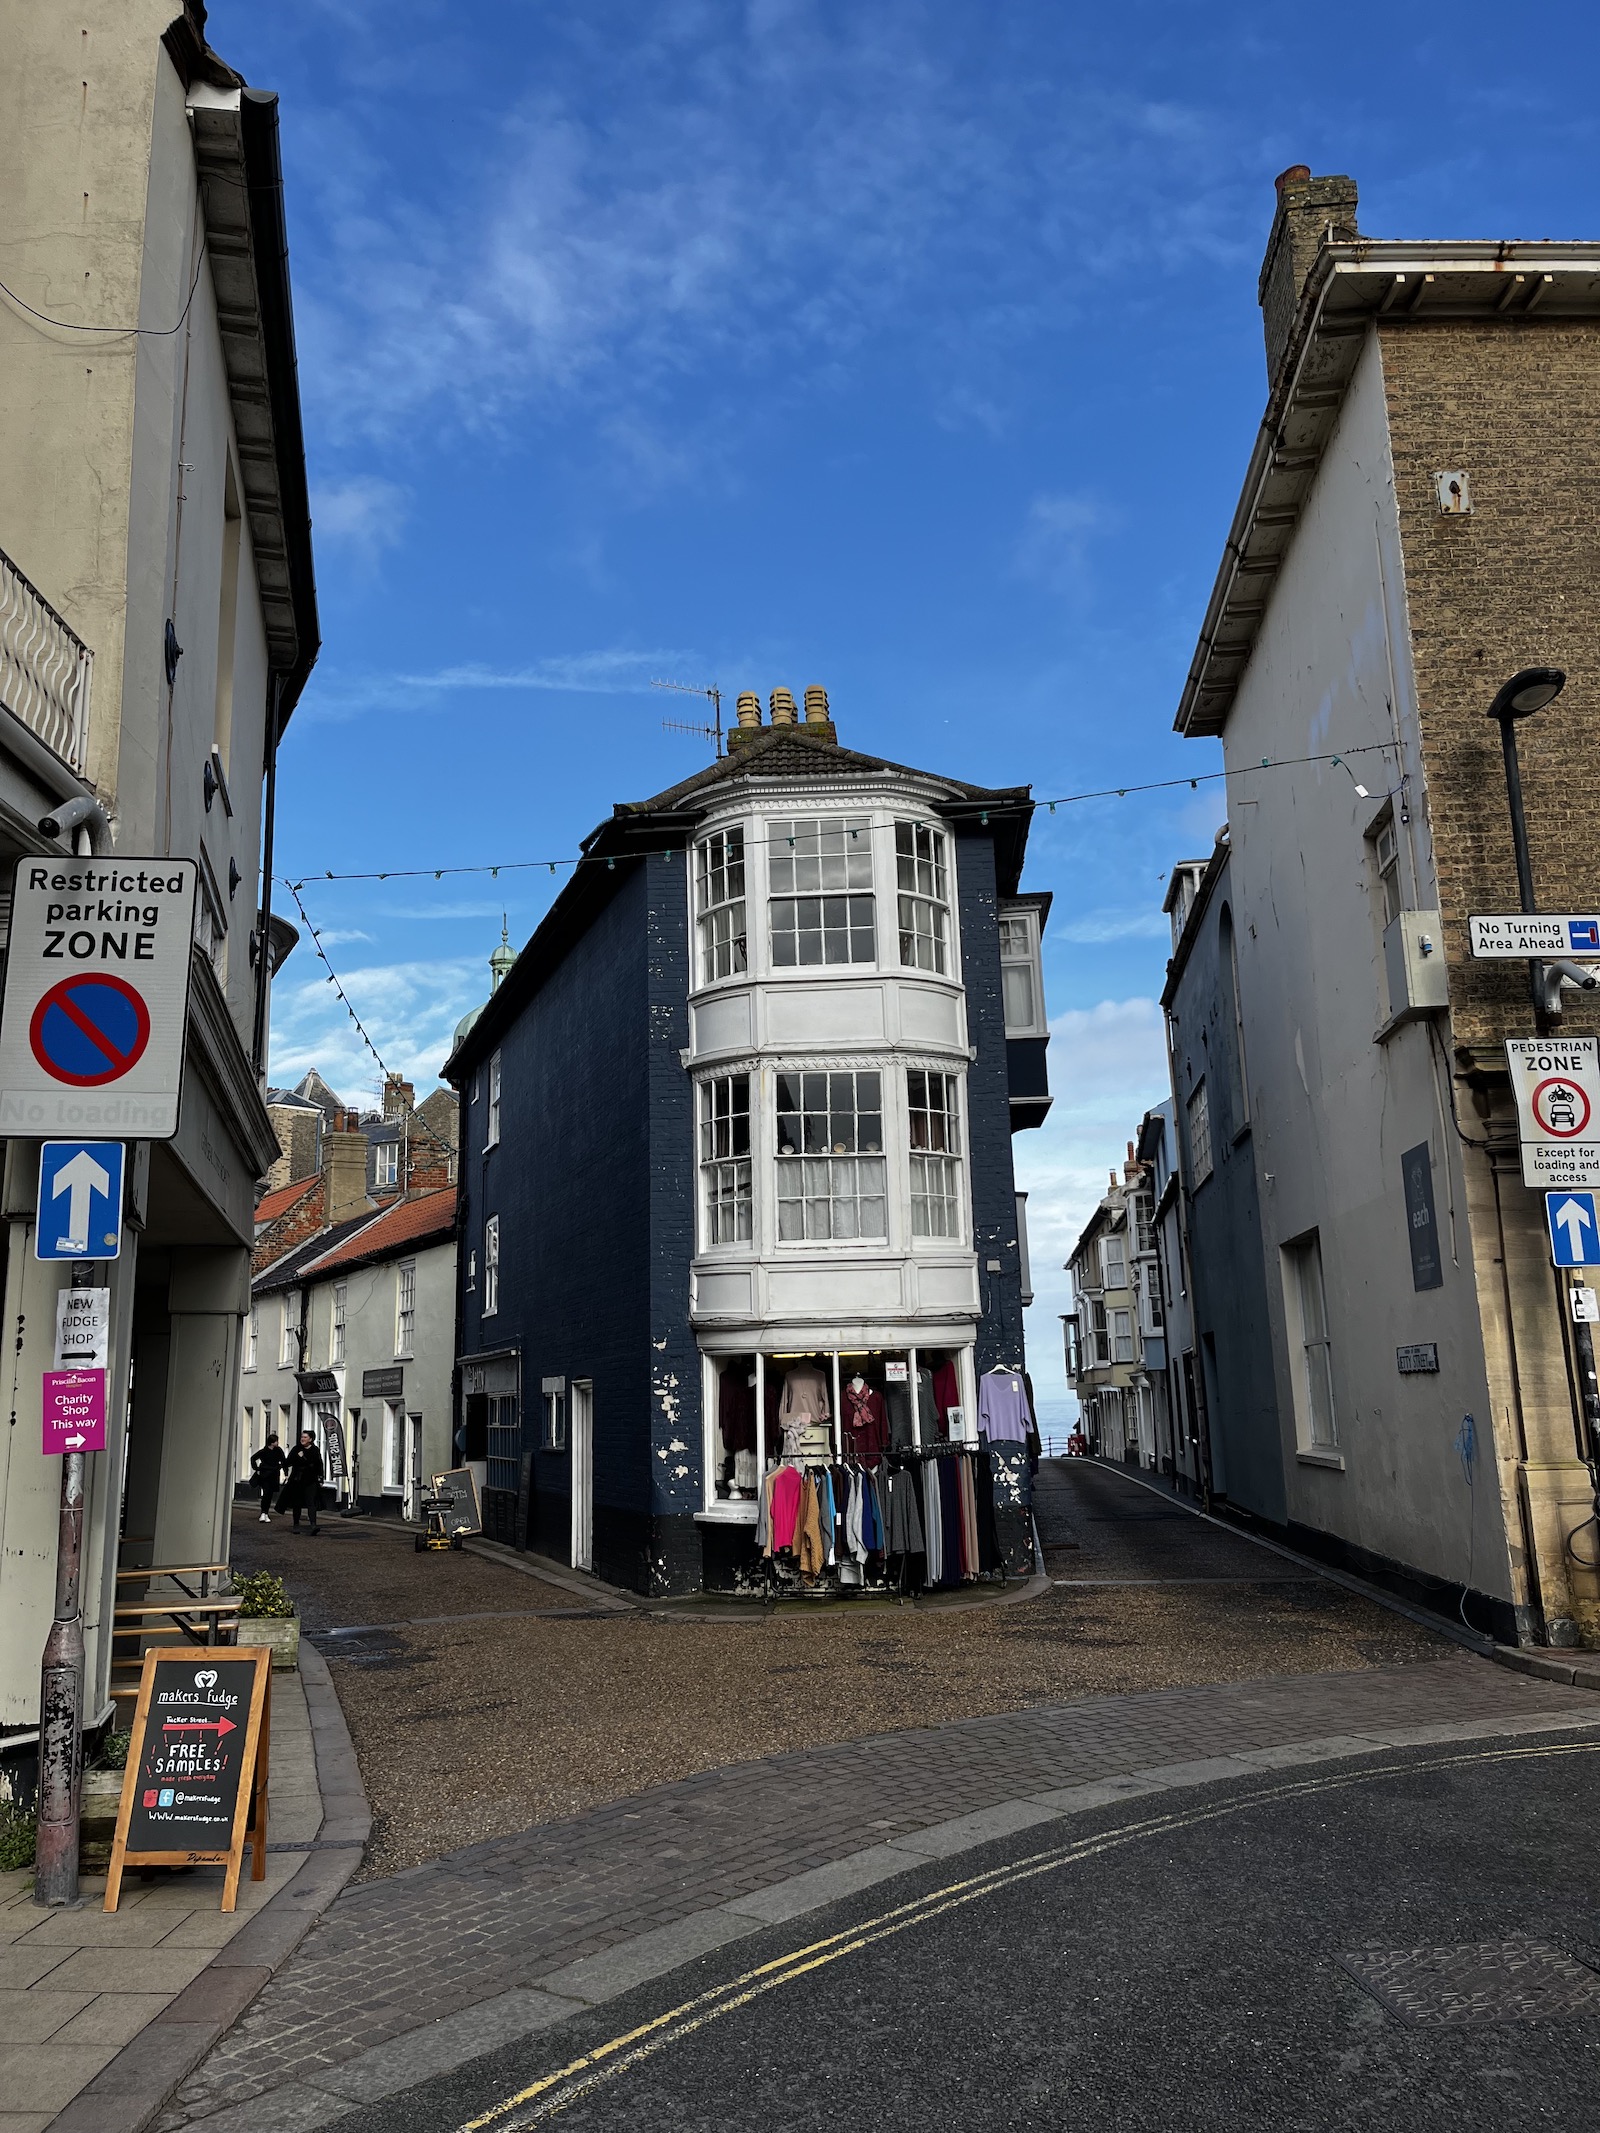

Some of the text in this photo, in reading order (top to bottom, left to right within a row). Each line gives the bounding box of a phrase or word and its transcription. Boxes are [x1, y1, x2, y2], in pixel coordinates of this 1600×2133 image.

[29, 868, 184, 894] Restricted
[46, 900, 159, 927] parking
[1479, 922, 1561, 935] No Turning
[42, 931, 155, 960] ZONE
[1479, 937, 1565, 949] Area Ahead
[1511, 1042, 1593, 1053] PEDESTRIAN
[1525, 1056, 1583, 1071] ZONE
[1, 1098, 168, 1129] No loading
[1536, 1147, 1595, 1159] Except for
[1534, 1160, 1600, 1171] loading and
[1549, 1174, 1587, 1182] access
[1412, 1202, 1430, 1229] each
[67, 1298, 94, 1310] NEW
[62, 1316, 99, 1328] FUDGE
[63, 1333, 94, 1345] SHOP
[52, 1378, 76, 1386] Priscilla
[55, 1393, 94, 1405] Charity
[62, 1405, 90, 1416] Shop
[51, 1418, 98, 1430] This way
[158, 1688, 239, 1710] makers fudge
[169, 1744, 207, 1758] FREE
